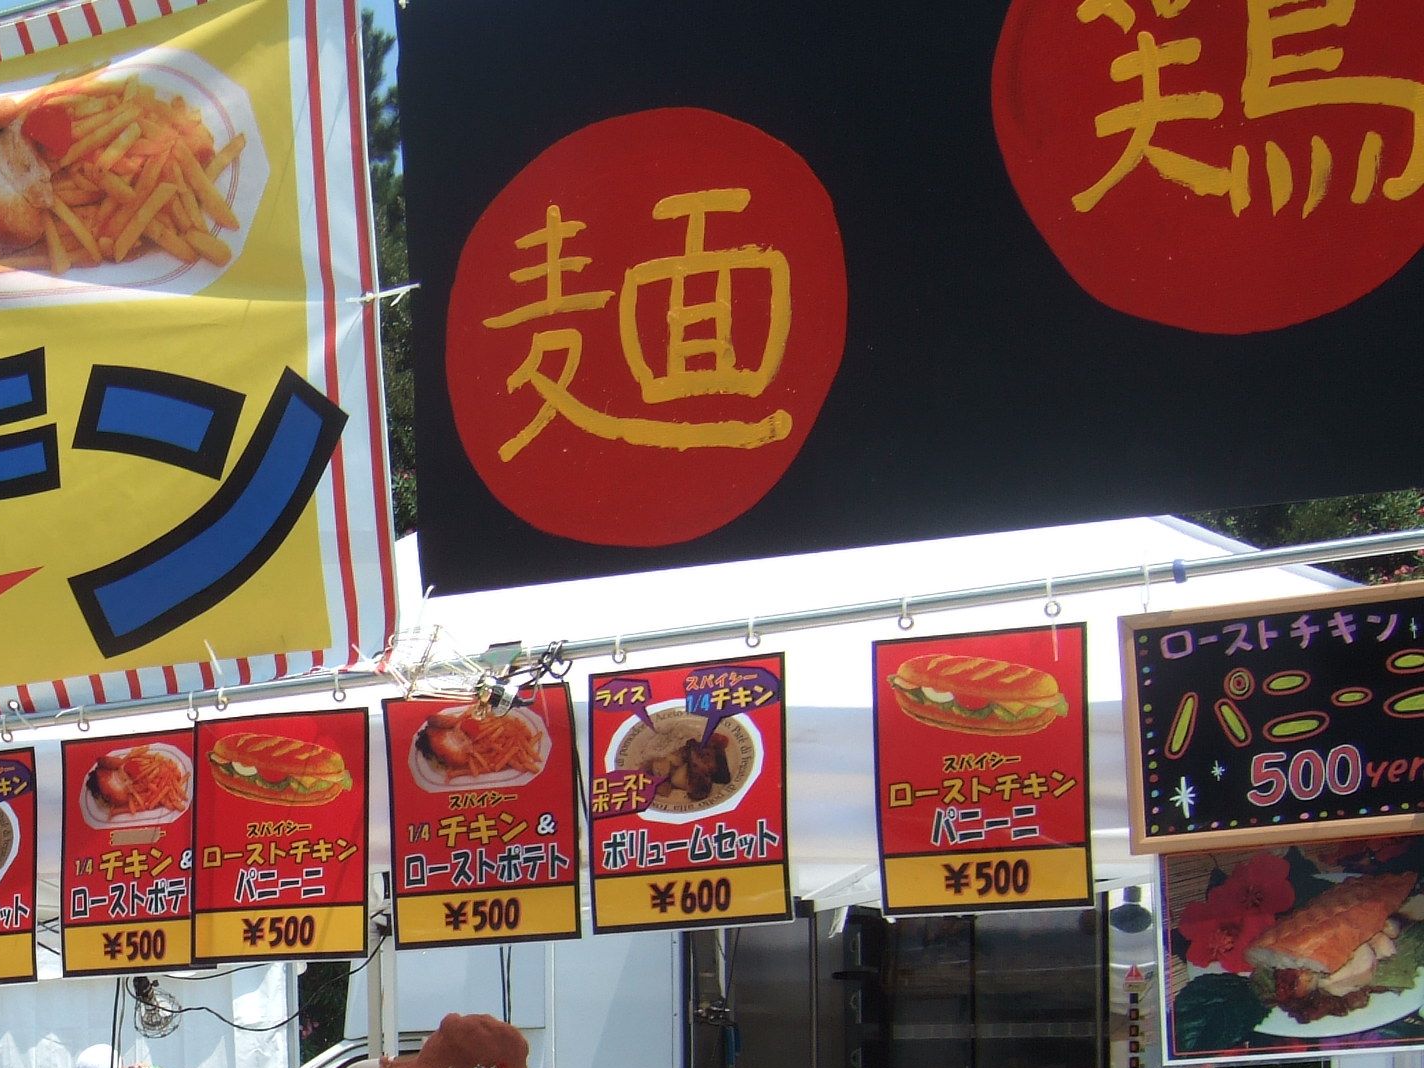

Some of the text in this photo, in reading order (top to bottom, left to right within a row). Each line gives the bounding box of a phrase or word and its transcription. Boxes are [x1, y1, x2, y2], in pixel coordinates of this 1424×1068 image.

[482, 188, 794, 462] 麺
[1160, 612, 1398, 660] ローストチキン
[595, 686, 646, 707] ライス
[685, 670, 758, 691] スパイシー
[1164, 649, 1424, 759] パニーニ
[942, 752, 1020, 772] スパイシー
[449, 791, 519, 809] スパイシー
[592, 773, 652, 796] ロースト
[889, 770, 1076, 808] ローストチキン
[591, 791, 647, 814] ポテト
[247, 821, 312, 838] スパイシー
[407, 811, 557, 849] 1/4 チキン &
[930, 805, 1039, 847] パニーニ
[202, 838, 358, 869] ローストチキン
[603, 819, 779, 870] ボリュームセット
[99, 847, 173, 881] チキン
[403, 842, 570, 889] ローストポテト
[942, 859, 1030, 896] ¥500
[71, 877, 193, 919] ローストポテ
[234, 867, 326, 903] パニーニ
[650, 878, 732, 914] ¥600
[242, 914, 316, 947] ¥500
[443, 897, 521, 932] ¥500
[102, 929, 167, 962] ¥500
